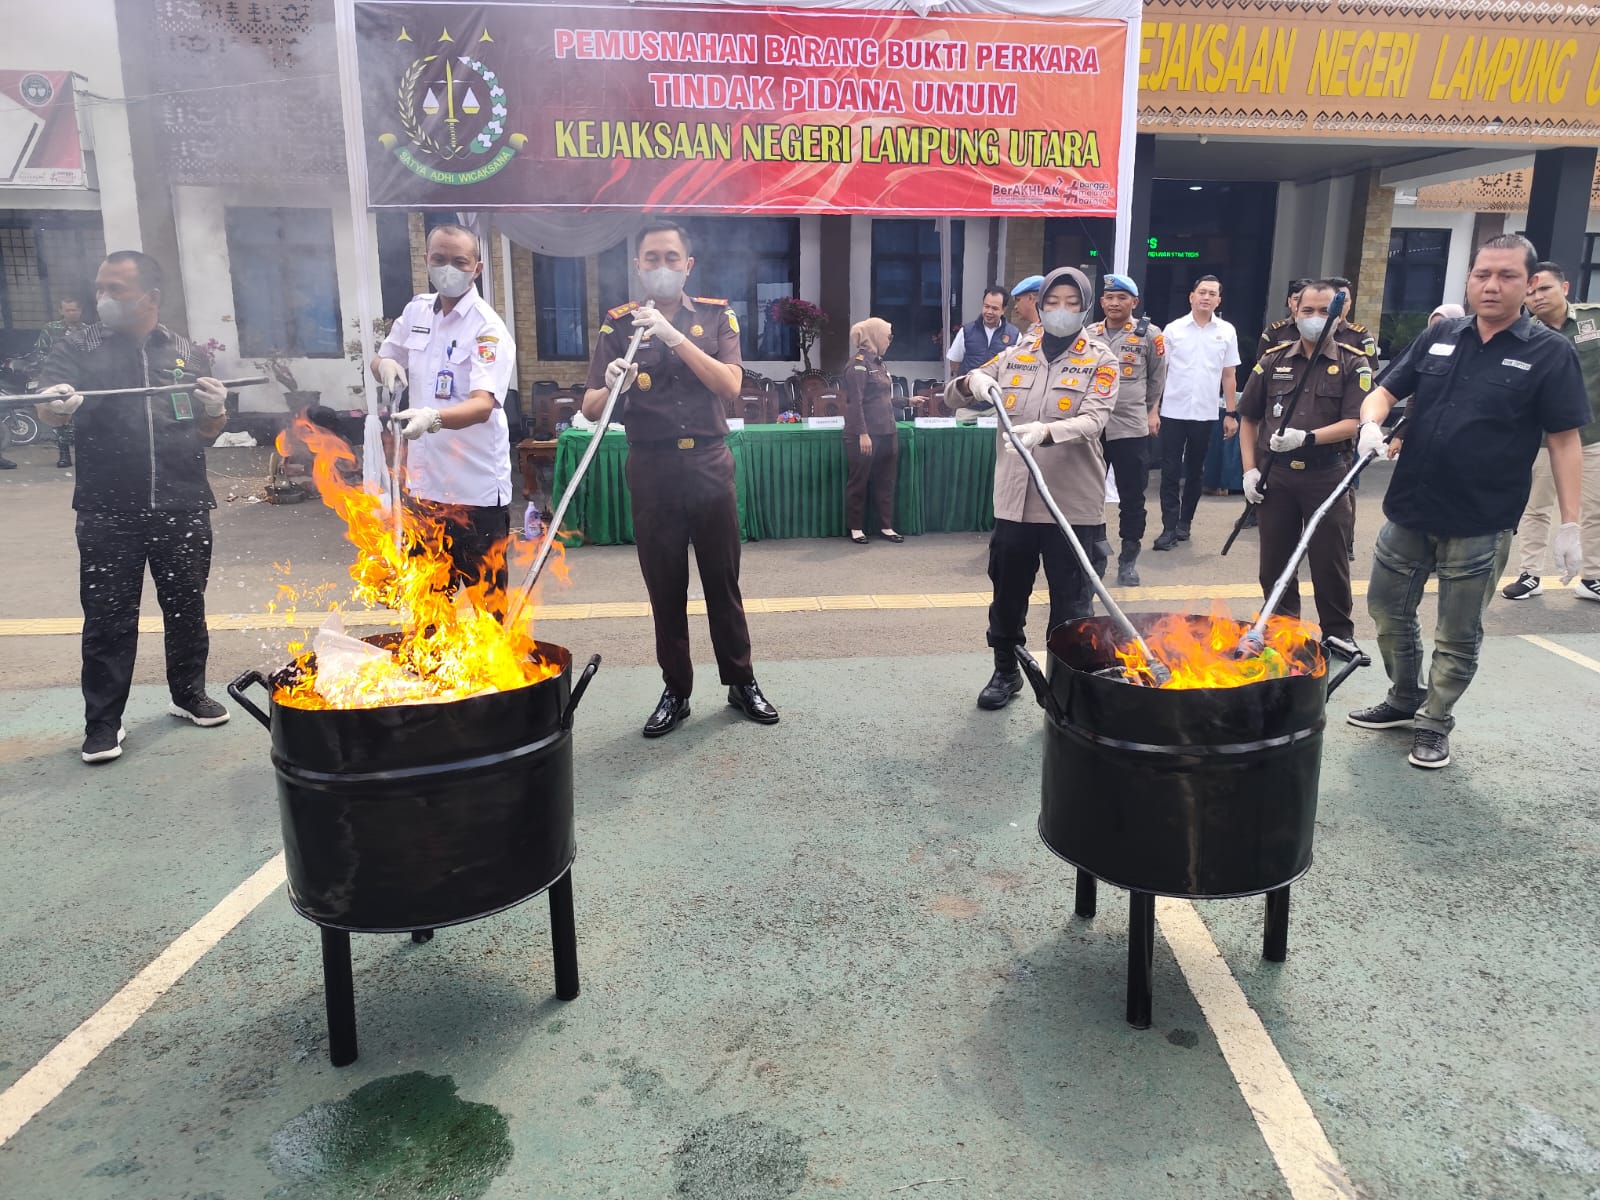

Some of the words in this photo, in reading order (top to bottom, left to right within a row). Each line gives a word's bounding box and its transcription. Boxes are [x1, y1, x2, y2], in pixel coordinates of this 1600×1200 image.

[554, 29, 757, 64] PEMUSNAHAN
[765, 35, 879, 67] BARANG
[886, 39, 968, 71] BUKTI
[975, 42, 1100, 74] PERKARA
[1138, 21, 1298, 95] EJAKSAAN
[1306, 28, 1420, 98] NEGERI
[1428, 34, 1578, 104] LAMPUNG
[648, 73, 775, 110] TINDAK
[783, 77, 905, 113] PIDANA
[912, 80, 1018, 115] UMUM
[554, 120, 732, 161] KEJAKSAAN
[741, 122, 852, 163] NEGERI
[861, 126, 1000, 167] LAMPUNG
[1008, 129, 1101, 168] UTARA
[400, 151, 427, 175] SATYA
[430, 171, 455, 182] ADHI
[458, 151, 511, 182] WICAKSANA
[993, 184, 1060, 196] BerAKHLAK
[1120, 345, 1142, 354] POLRI
[1061, 366, 1093, 375] POLRI
